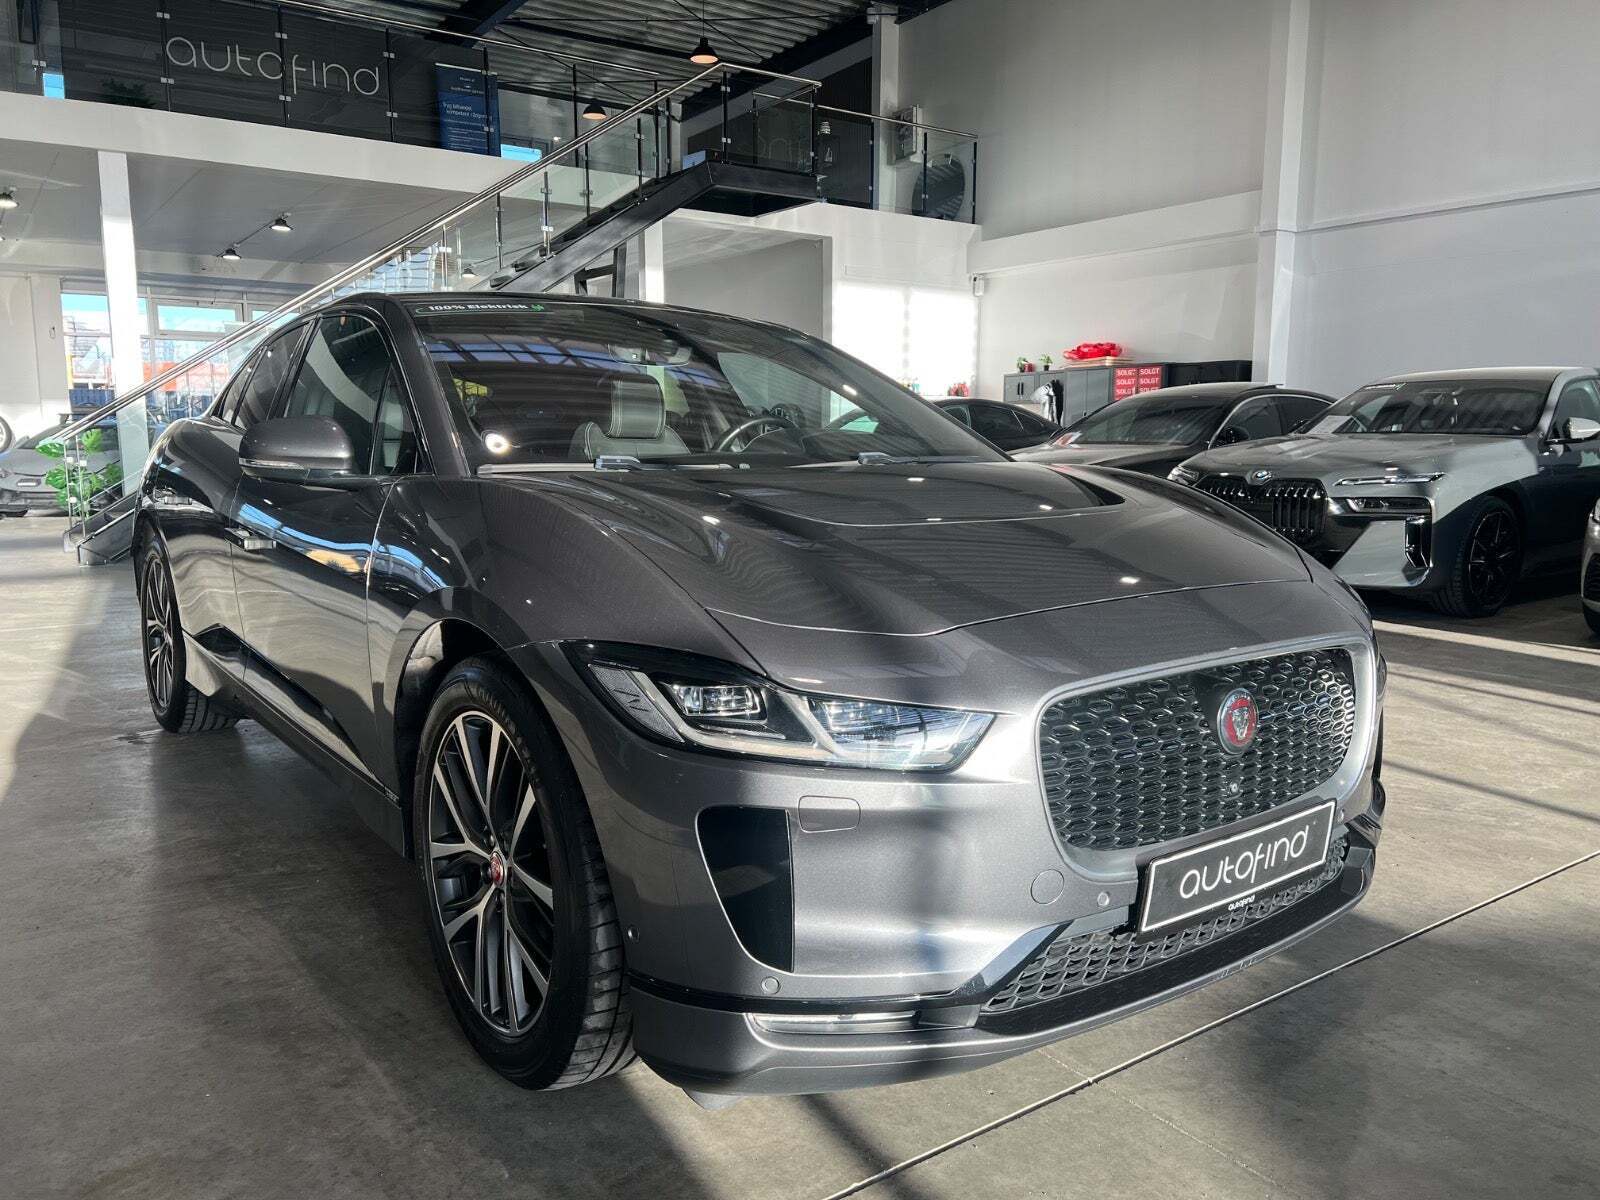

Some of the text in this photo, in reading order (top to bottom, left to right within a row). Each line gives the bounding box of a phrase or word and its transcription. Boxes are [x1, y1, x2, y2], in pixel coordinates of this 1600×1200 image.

[165, 36, 379, 95] autofind
[1179, 824, 1309, 899] autofind
[1228, 894, 1256, 911] autofind
